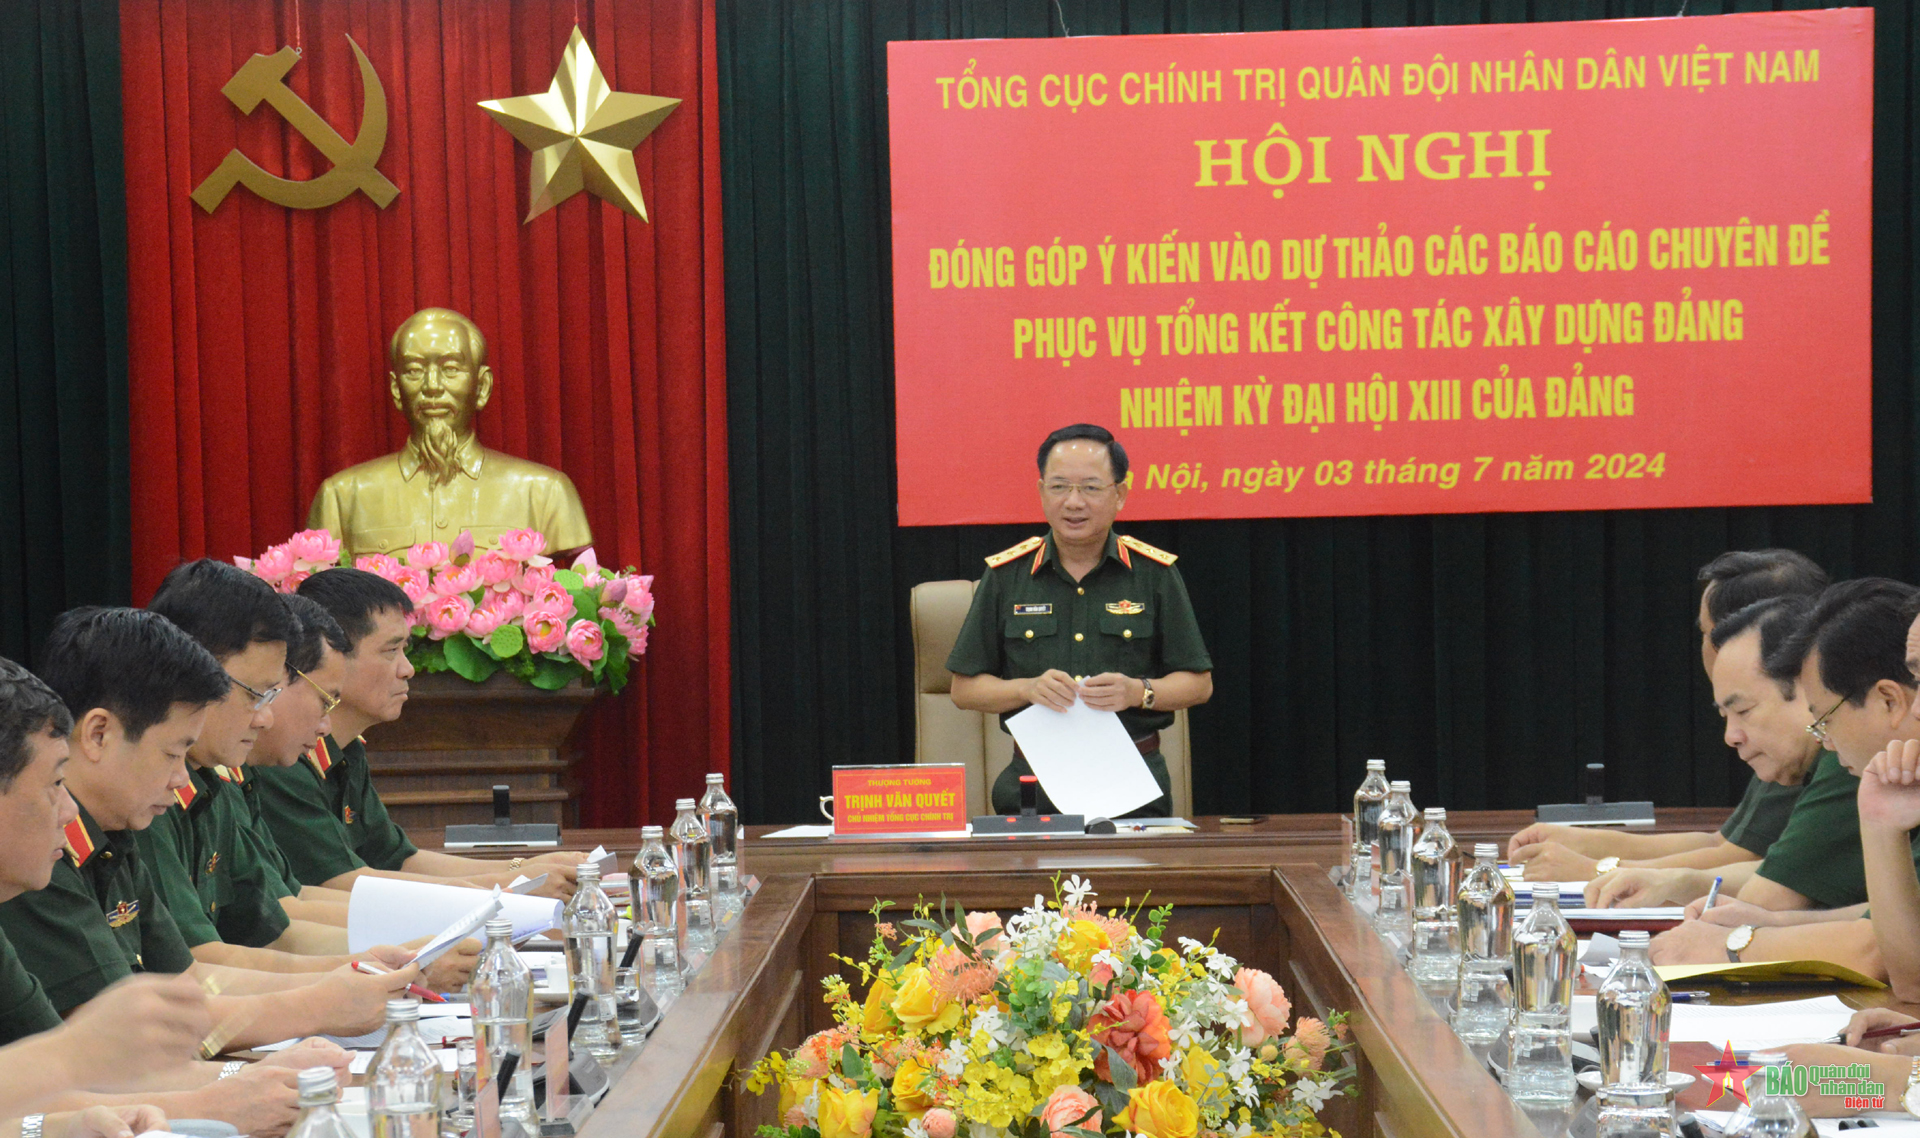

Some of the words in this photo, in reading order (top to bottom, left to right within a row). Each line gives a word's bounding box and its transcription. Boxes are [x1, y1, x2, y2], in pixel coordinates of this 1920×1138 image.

[936, 58, 1028, 109] TỔNG
[1040, 73, 1108, 113] CỤC
[1119, 62, 1222, 105] CHÍNH
[1233, 67, 1286, 107] TRỊ
[1298, 56, 1391, 100] QUÂN
[1402, 53, 1458, 102] ĐỘI
[1470, 49, 1564, 93] NHÂN
[1576, 47, 1646, 90] DÂN
[1658, 43, 1734, 93] VIỆT
[1744, 49, 1820, 83] NAM
[1194, 122, 1332, 199] HỘI
[1357, 129, 1552, 191] NGHỊ
[929, 239, 1015, 289] ĐÓNG
[1026, 237, 1088, 287] GÓP
[1098, 236, 1117, 285] Ý
[1127, 229, 1200, 284] KIẾN
[1210, 232, 1271, 281] VÀO
[1282, 234, 1327, 289] DỰ
[1333, 222, 1414, 278] THẢO
[1425, 225, 1488, 276] CÁC
[1499, 223, 1563, 274] BÁO
[1574, 221, 1638, 272] CÁO
[1649, 217, 1778, 270] CHUYÊN
[1787, 209, 1831, 265] ĐỀ
[1014, 316, 1097, 367] PHỤC
[1107, 316, 1146, 366] VỤ
[1156, 297, 1239, 355] TỔNG
[1249, 298, 1306, 353] KẾT
[1316, 301, 1403, 351] CÔNG
[1412, 299, 1472, 348] TÁC
[1483, 296, 1545, 347] XÂY
[1555, 299, 1643, 354] DỰNG
[1653, 286, 1743, 342] ĐẢNG
[1120, 377, 1223, 436] NHIỆM
[1233, 375, 1273, 425] KỲ
[1282, 383, 1335, 433] ĐẠI
[1346, 372, 1398, 431] HỘI
[1409, 379, 1461, 421] XIII
[1472, 364, 1536, 419] CỦA
[1545, 362, 1634, 417] ĐẢNG
[1145, 463, 1209, 495] Nội,
[1221, 460, 1305, 494] ngày
[1314, 460, 1354, 486] 03
[1364, 457, 1461, 490] tháng
[1473, 456, 1494, 482] 7
[1501, 454, 1574, 481] năm
[1585, 452, 1666, 480] 2024
[844, 794, 882, 811] TRỊNH
[886, 791, 912, 808] VĂN
[916, 788, 955, 808] QUYẾT
